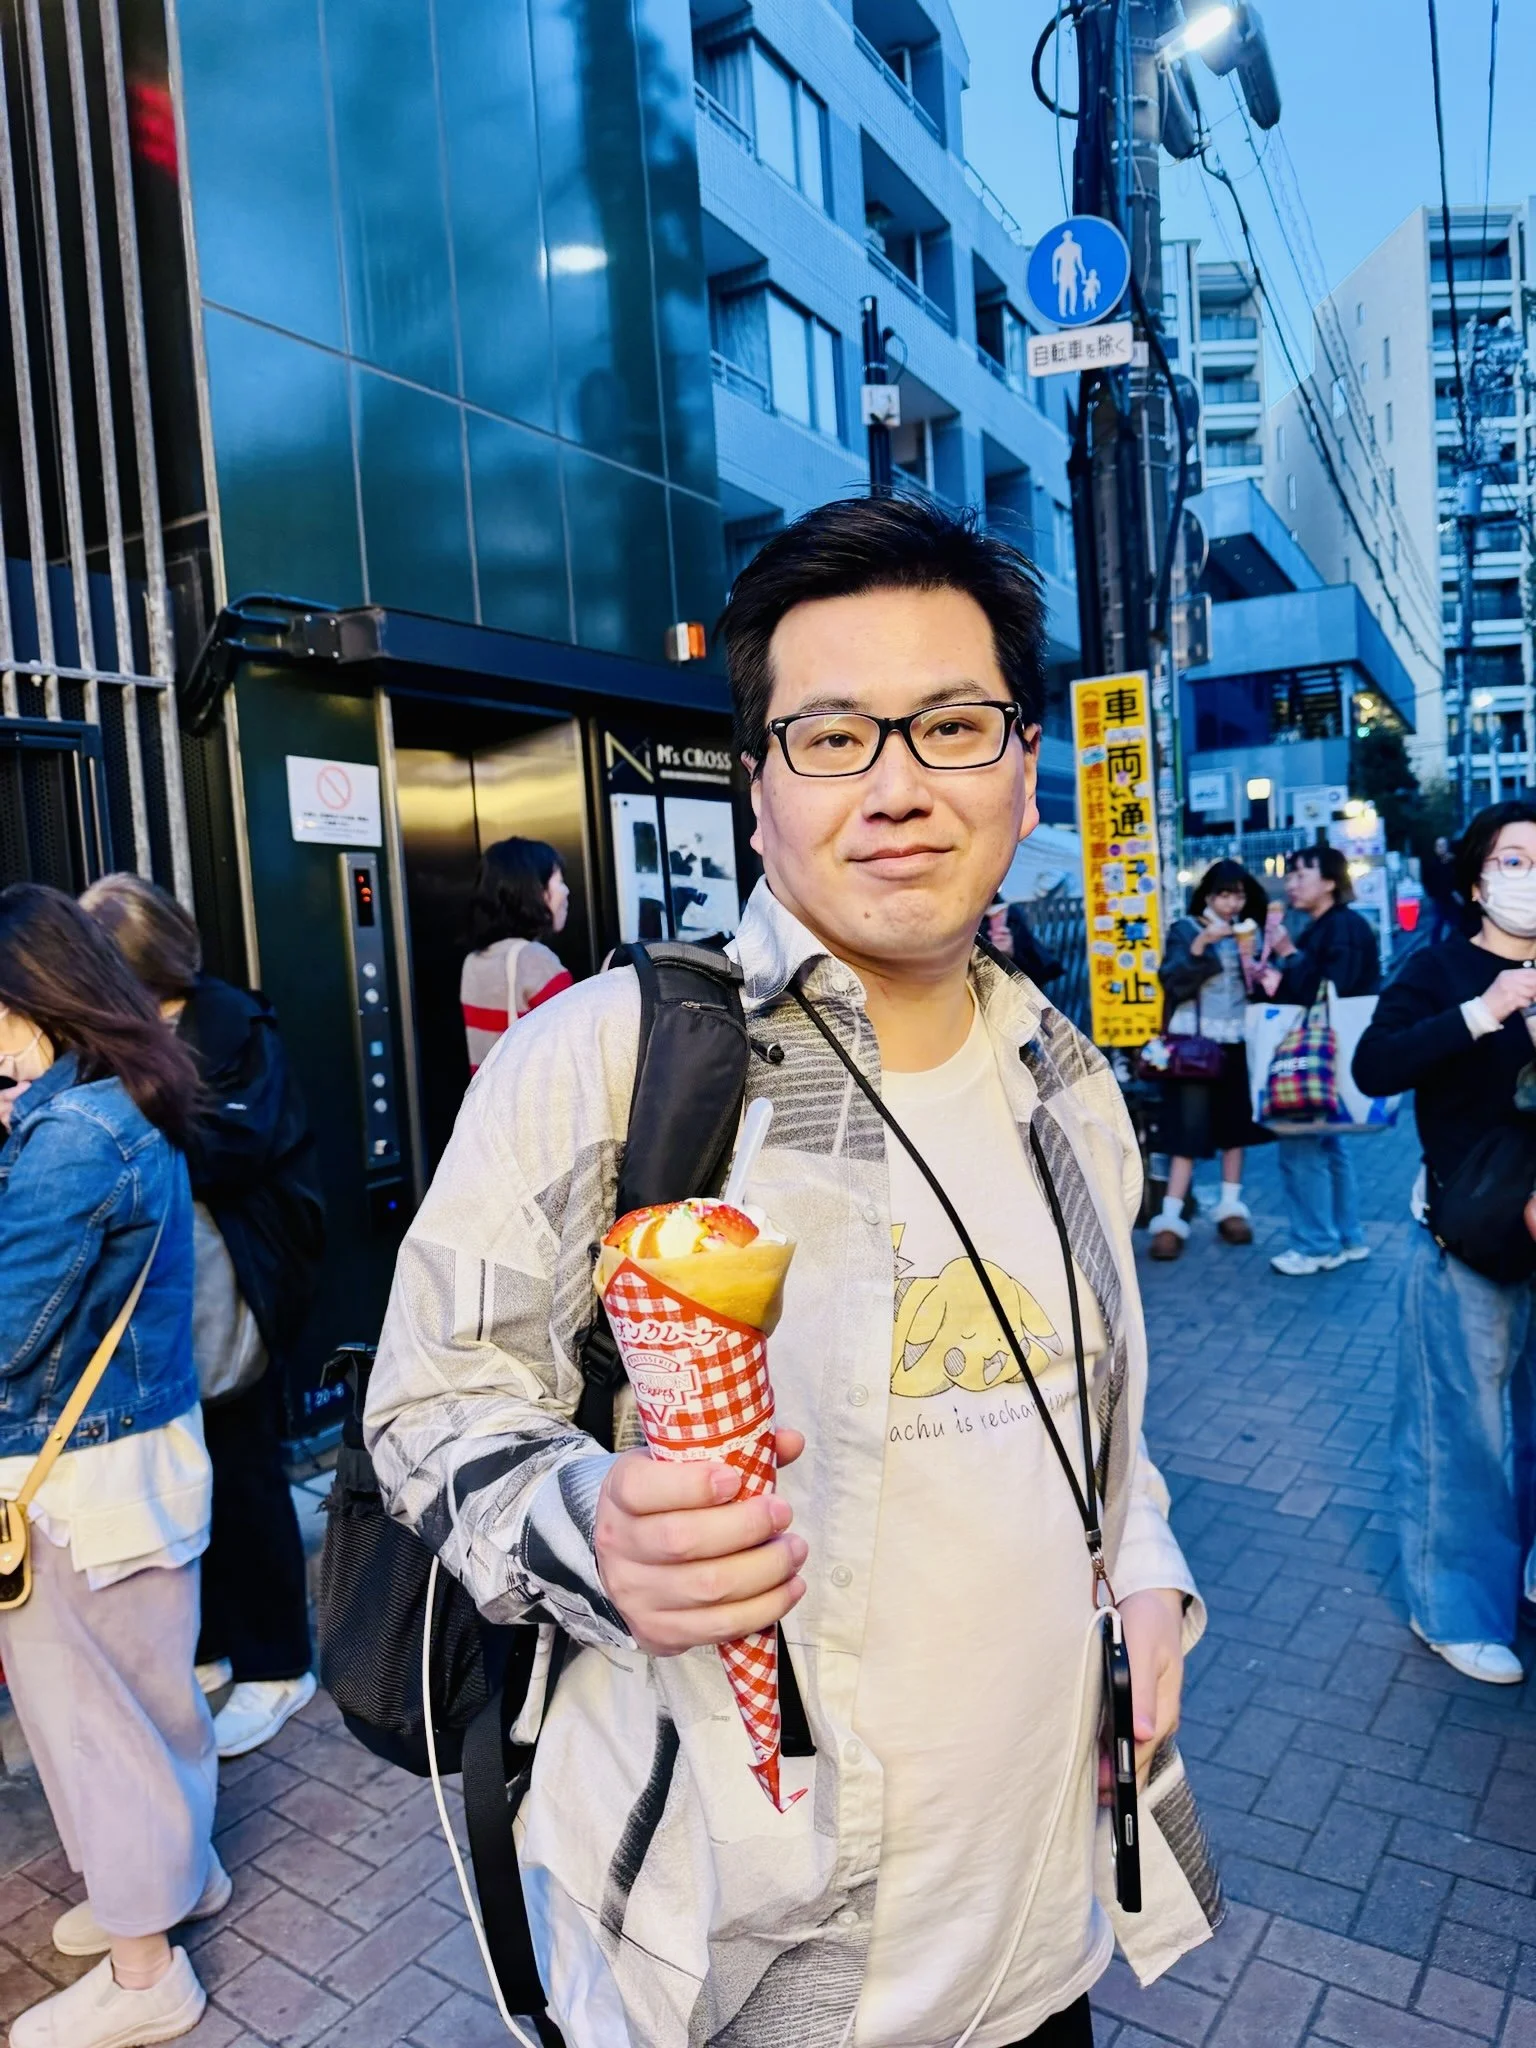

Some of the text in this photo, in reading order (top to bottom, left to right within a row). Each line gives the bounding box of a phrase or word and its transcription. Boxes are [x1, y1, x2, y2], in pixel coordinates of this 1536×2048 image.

[1033, 333, 1127, 367] 自転車を除く
[682, 747, 733, 771] CROSS
[953, 1406, 974, 1435] is
